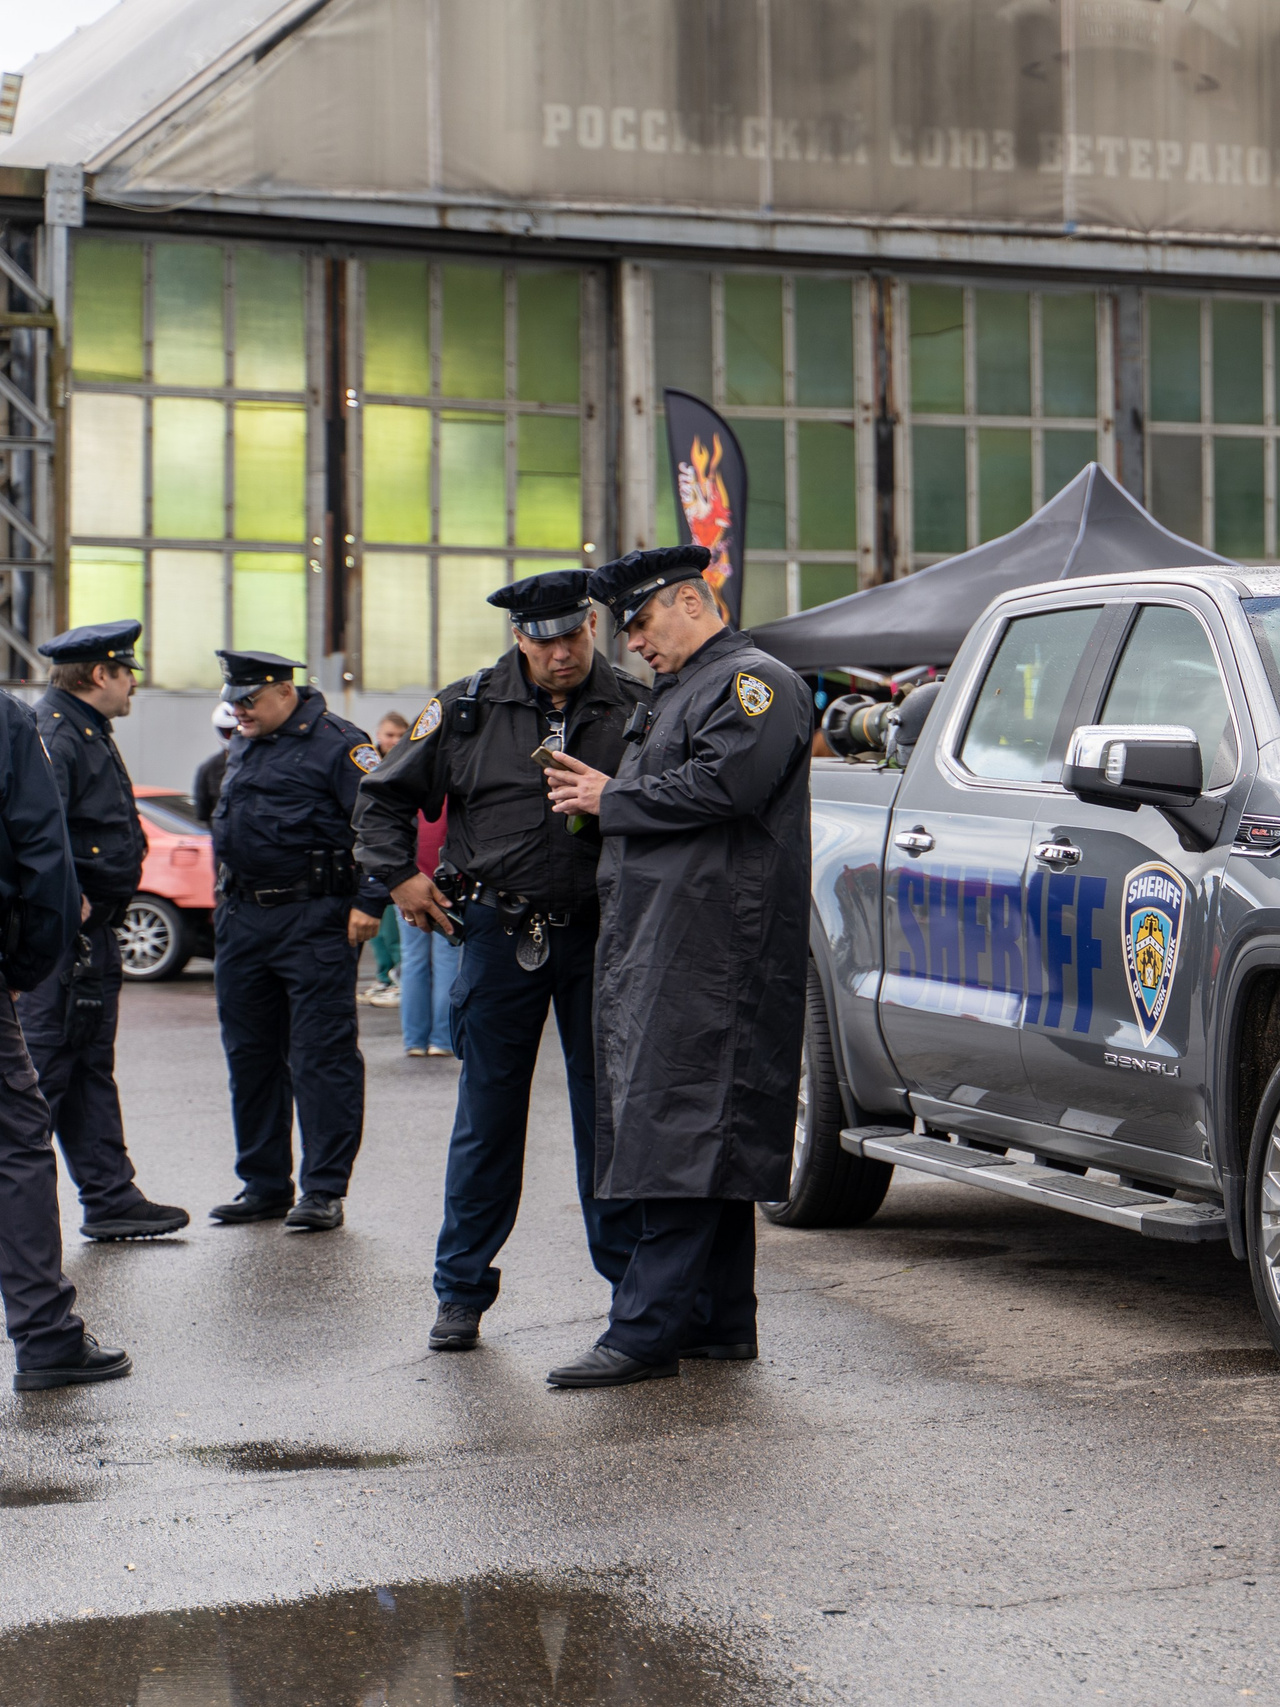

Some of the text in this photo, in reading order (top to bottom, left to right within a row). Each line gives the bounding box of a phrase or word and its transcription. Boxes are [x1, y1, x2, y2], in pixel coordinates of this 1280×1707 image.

[1127, 875, 1181, 909] SHERIFF
[897, 860, 1107, 1034] SHERIFF
[1126, 934, 1142, 999] CITY OF
[1164, 936, 1177, 978] YORK
[1103, 1052, 1181, 1078] DENALI
